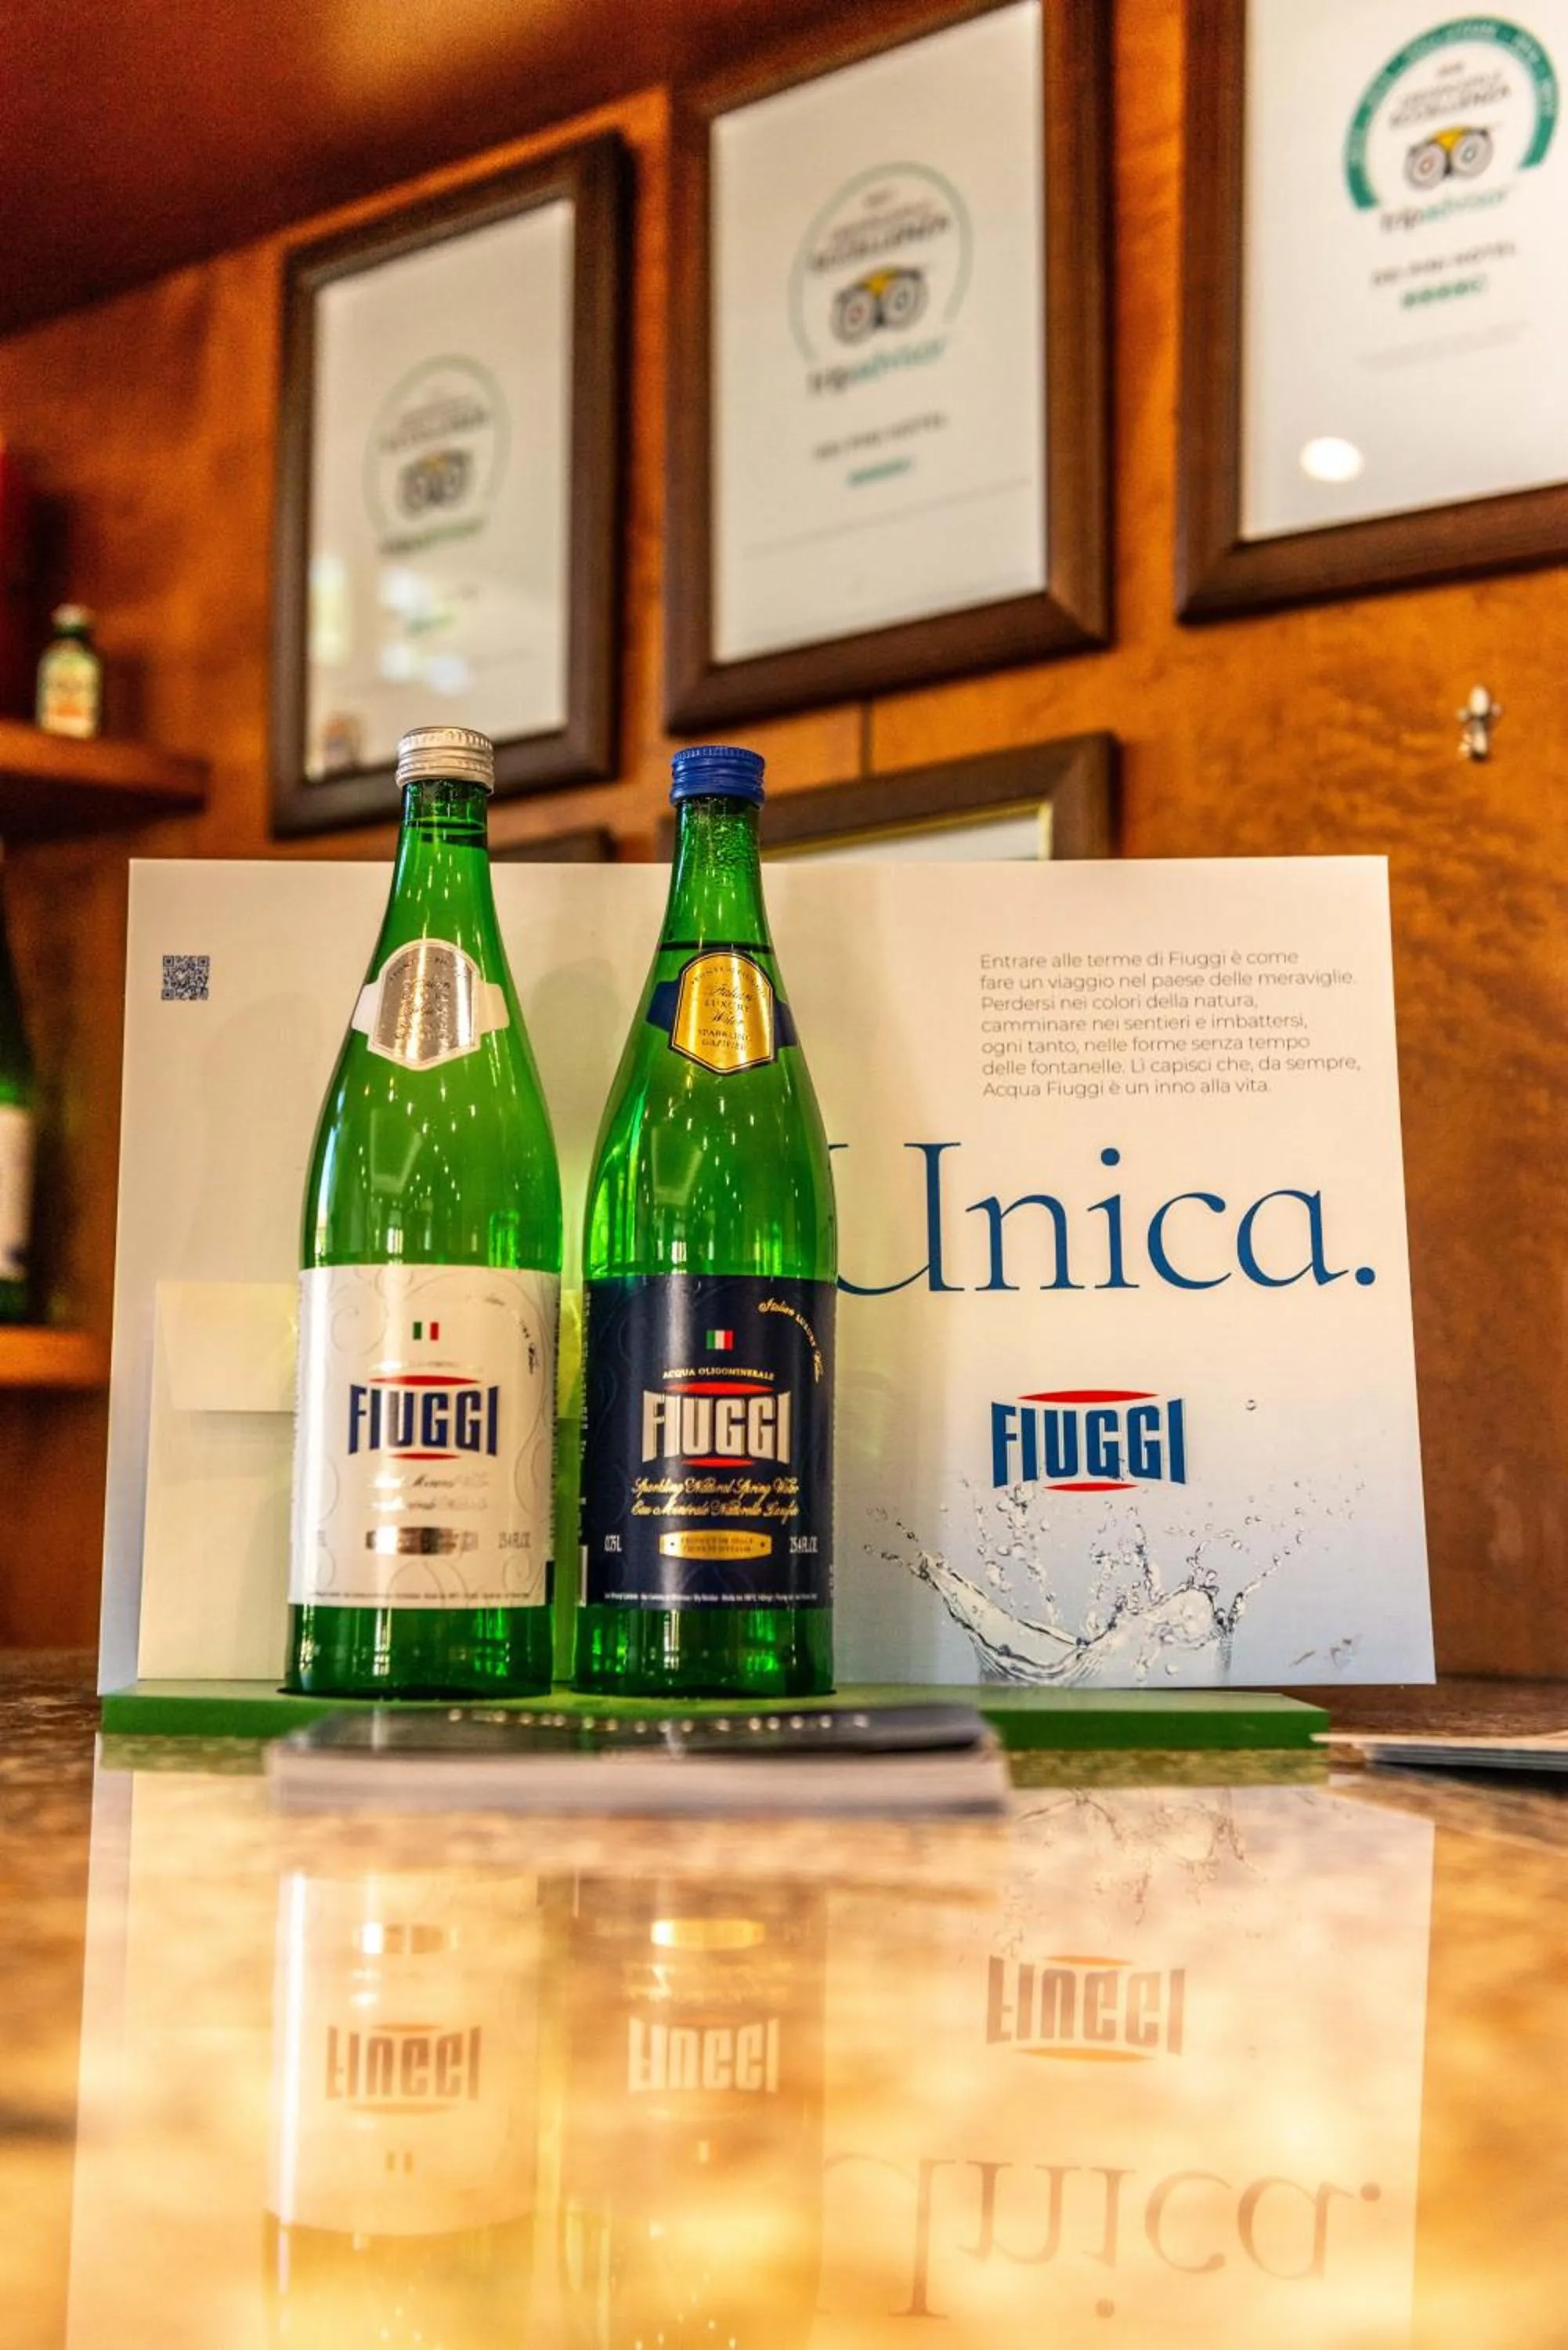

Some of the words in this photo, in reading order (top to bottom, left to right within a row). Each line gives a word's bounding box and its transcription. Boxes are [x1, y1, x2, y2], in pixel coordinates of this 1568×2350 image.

[980, 953, 1048, 969] Entrare
[1051, 952, 1082, 968] alle
[1086, 952, 1143, 967] terme
[1146, 951, 1165, 967] di
[1169, 949, 1227, 971] Fiuggi
[1230, 949, 1242, 965] è
[1245, 952, 1299, 965] come
[980, 974, 1015, 990] fare
[1019, 977, 1042, 990] un
[1046, 973, 1115, 993] viaggio
[1118, 972, 1147, 989] nel
[1151, 974, 1205, 992] paese
[1209, 971, 1253, 987] delle
[1257, 969, 1357, 990] meraviglie.
[981, 995, 1056, 1011] Perdersi
[1060, 994, 1088, 1010] nei
[1091, 993, 1142, 1010] colori
[1145, 992, 1189, 1009] della
[1194, 992, 1259, 1010] natura,
[981, 1015, 1088, 1032] camminare
[1092, 1015, 1119, 1031] nei
[1122, 1014, 1191, 1031] sentieri
[1194, 1017, 1207, 1029] e
[1210, 1012, 1308, 1032] imbattersi,
[981, 1038, 1022, 1058] ogni
[1027, 1037, 1081, 1056] tanto,
[1084, 1036, 1128, 1052] nelle
[1132, 1035, 1187, 1051] forme
[1190, 1037, 1243, 1050] senza
[1247, 1034, 1310, 1054] tempo
[981, 1059, 1027, 1076] delle
[1030, 1058, 1125, 1075] fontanelle.
[1130, 1058, 1146, 1073] Lì
[1150, 1056, 1212, 1077] capisci
[1216, 1055, 1254, 1074] che,
[1258, 1055, 1282, 1071] da
[1285, 1057, 1361, 1075] sempre,
[982, 1080, 1041, 1101] Acqua
[1046, 1079, 1104, 1100] Fiuggi
[1108, 1079, 1121, 1094] è
[1125, 1082, 1150, 1094] un
[1154, 1078, 1195, 1094] inno
[1199, 1077, 1230, 1094] alla
[1234, 1076, 1272, 1093] vita.
[828, 1142, 1376, 1297] Unica.
[663, 1368, 696, 1379] ACQUA
[348, 1383, 499, 1457] FIUGGI
[641, 1389, 792, 1465] FIUGGI
[991, 1397, 1187, 1489] FIUGGI
